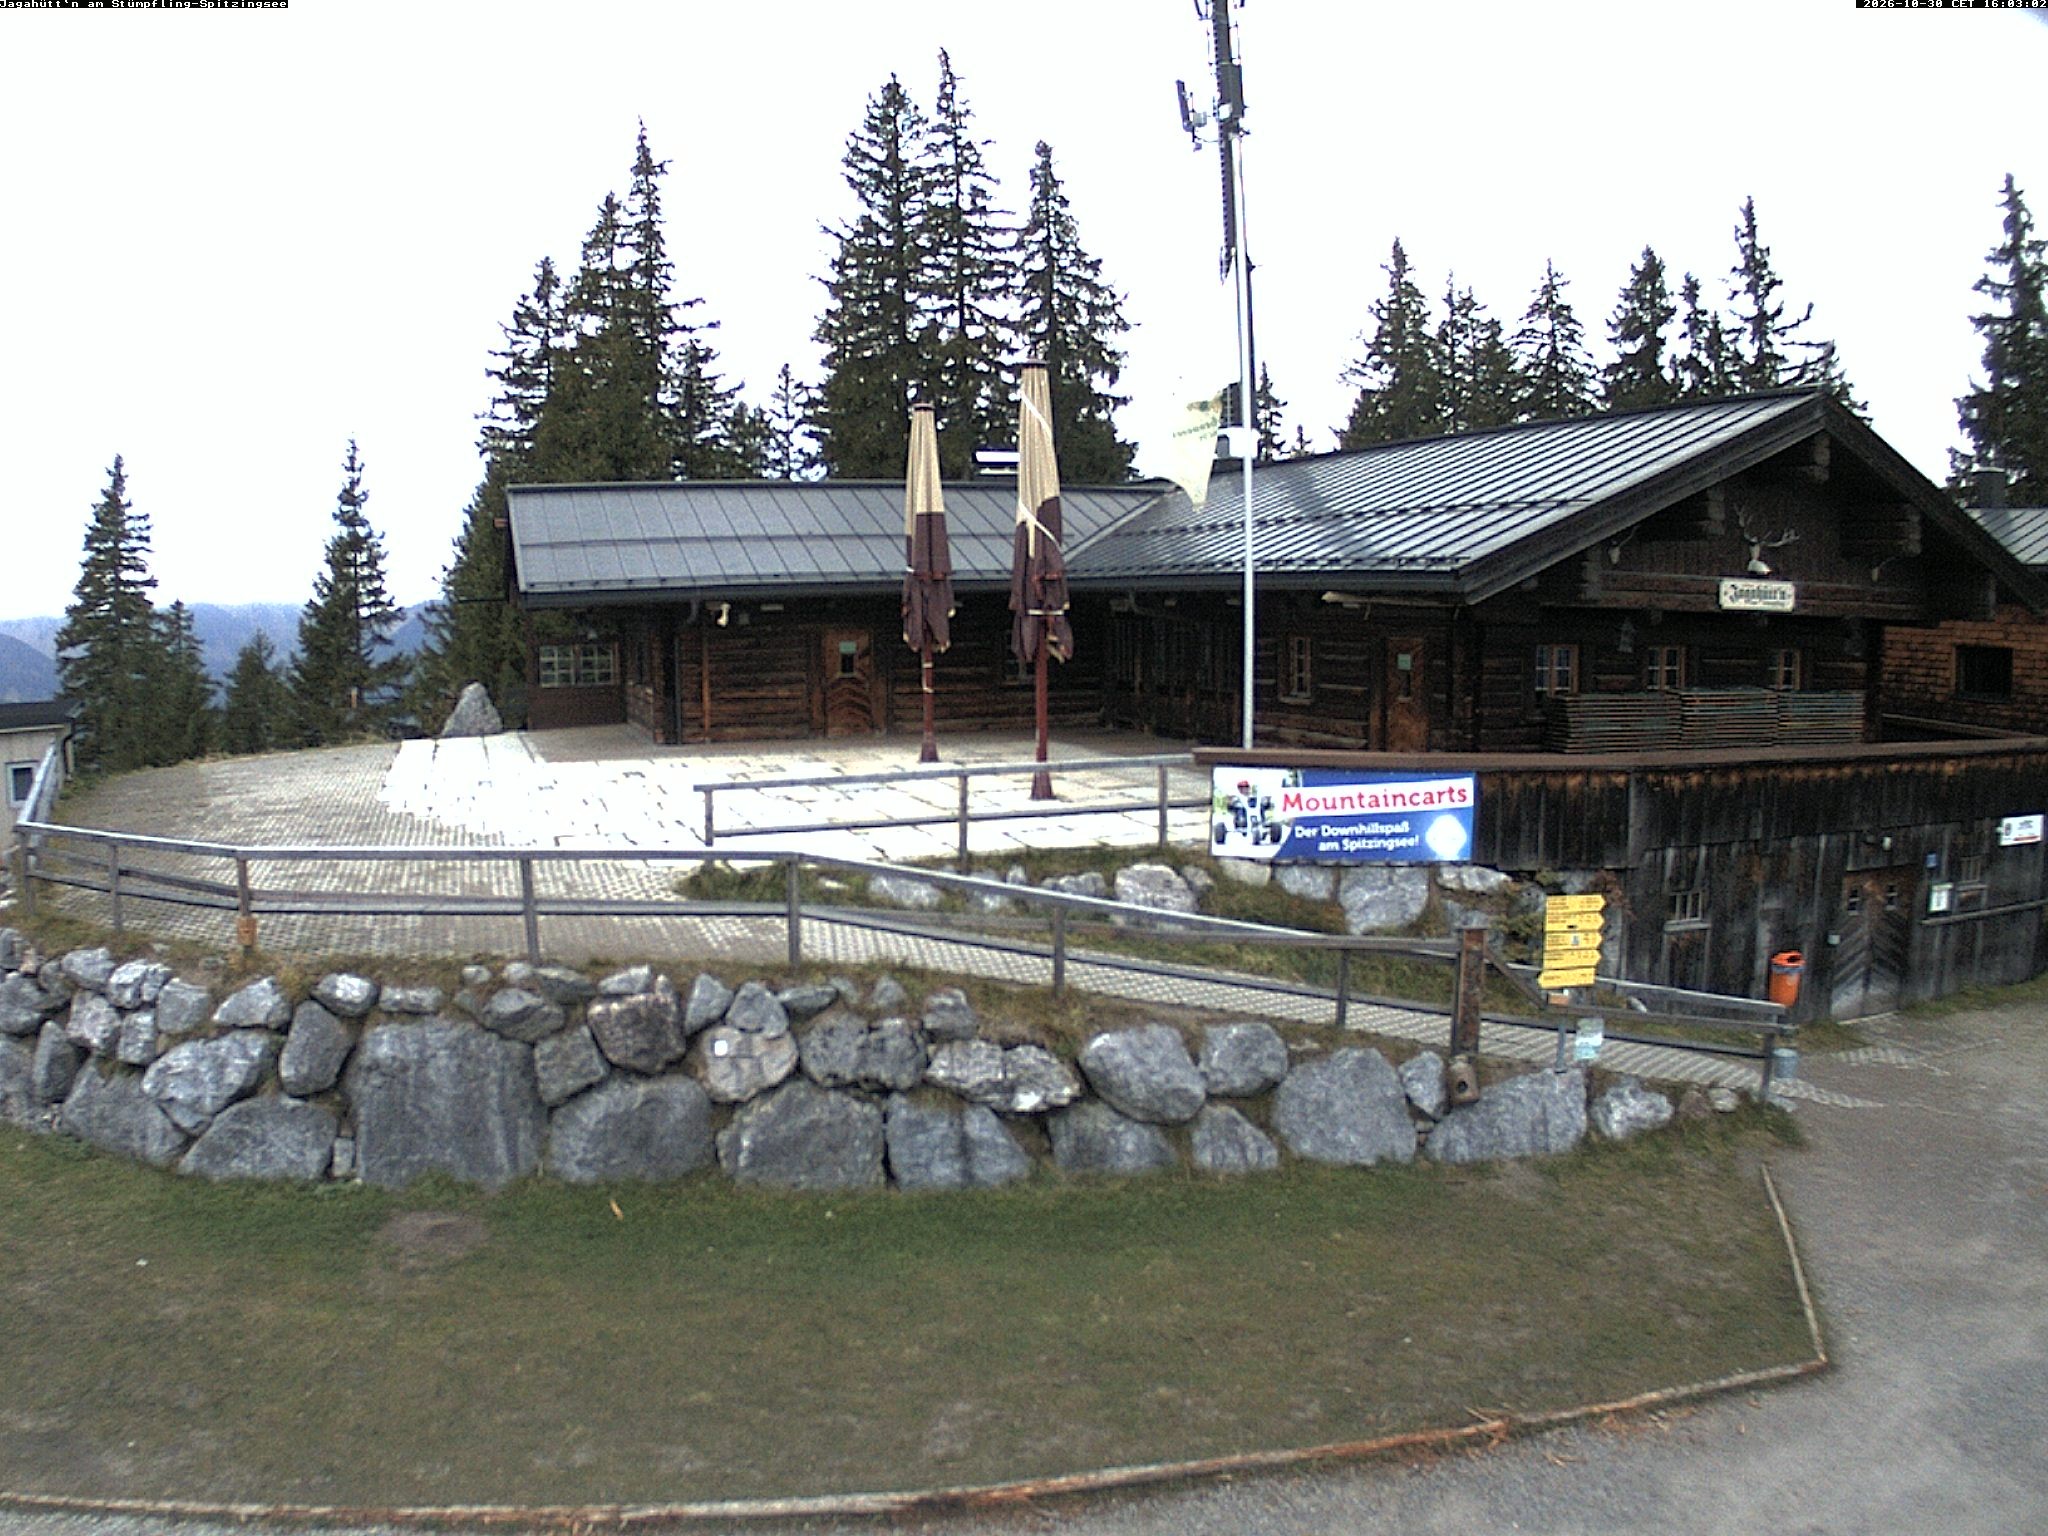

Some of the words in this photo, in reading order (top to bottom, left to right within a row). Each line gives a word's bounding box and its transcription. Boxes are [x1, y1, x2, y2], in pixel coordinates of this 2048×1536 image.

[1282, 785, 1468, 812] Mountaincarts
[1295, 825, 1318, 838] Der
[1321, 820, 1410, 837] Downhillspaß
[1318, 841, 1340, 851] am
[1341, 835, 1420, 852] Spitzingsee!
